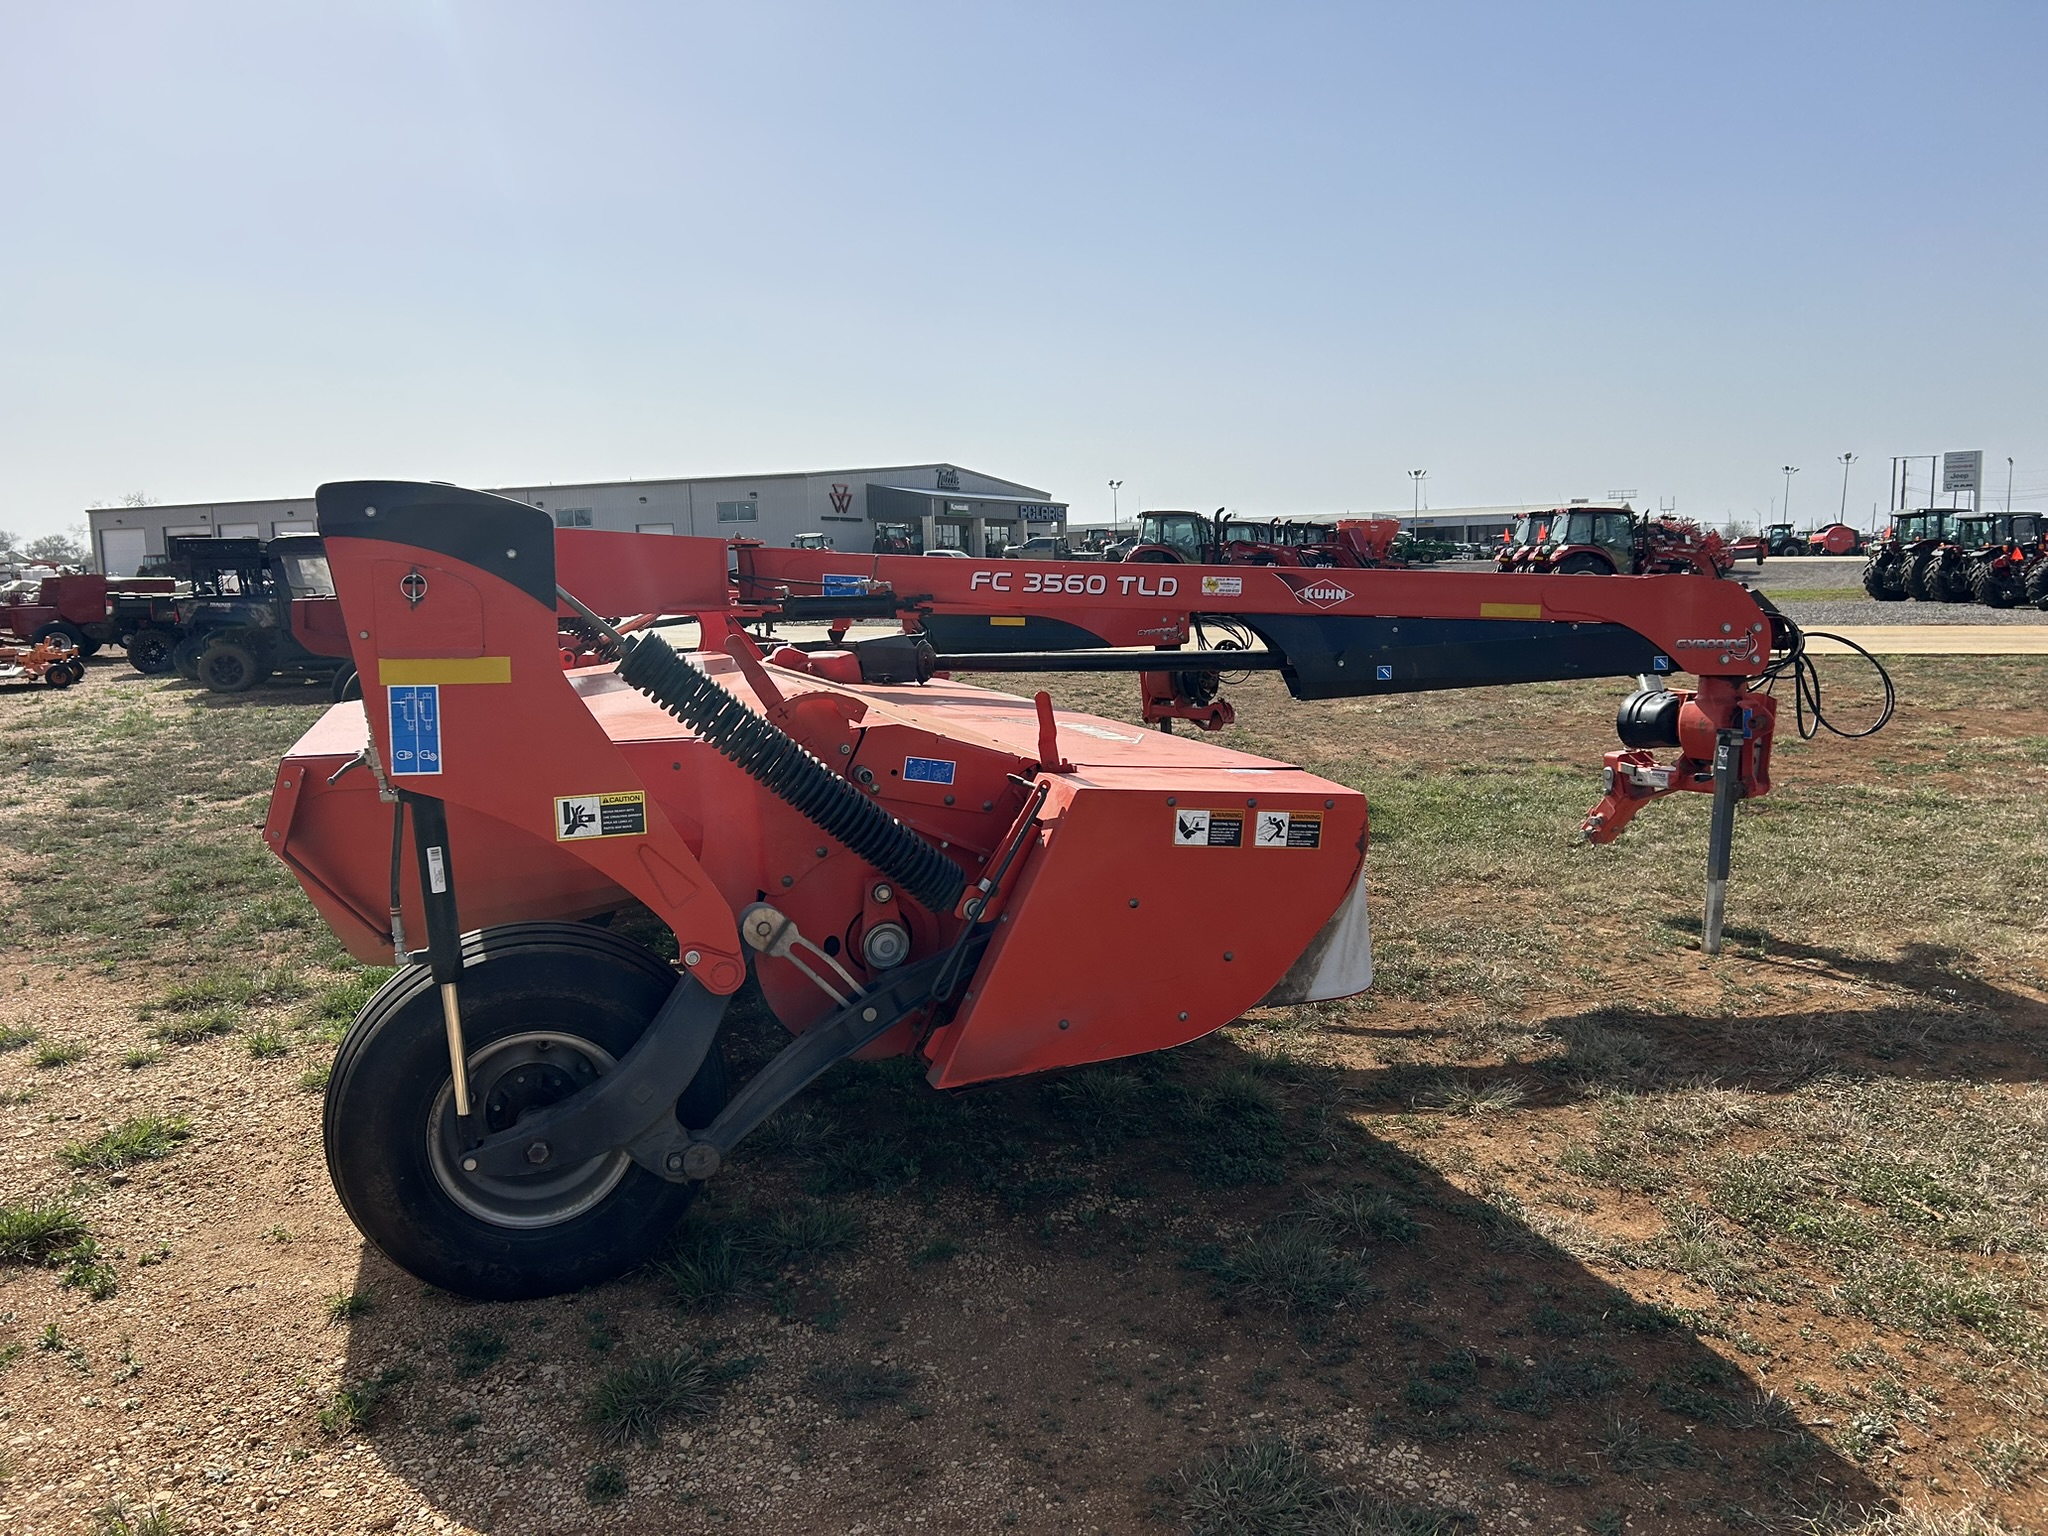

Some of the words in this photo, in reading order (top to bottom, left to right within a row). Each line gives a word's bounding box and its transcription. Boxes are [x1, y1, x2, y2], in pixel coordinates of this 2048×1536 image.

[1020, 505, 1065, 520] POLARIS
[970, 571, 1013, 591] FC
[1022, 572, 1107, 594] 3560
[1117, 576, 1178, 597] TLD
[1304, 588, 1346, 600] KUHN
[609, 795, 640, 803] CAUTION
